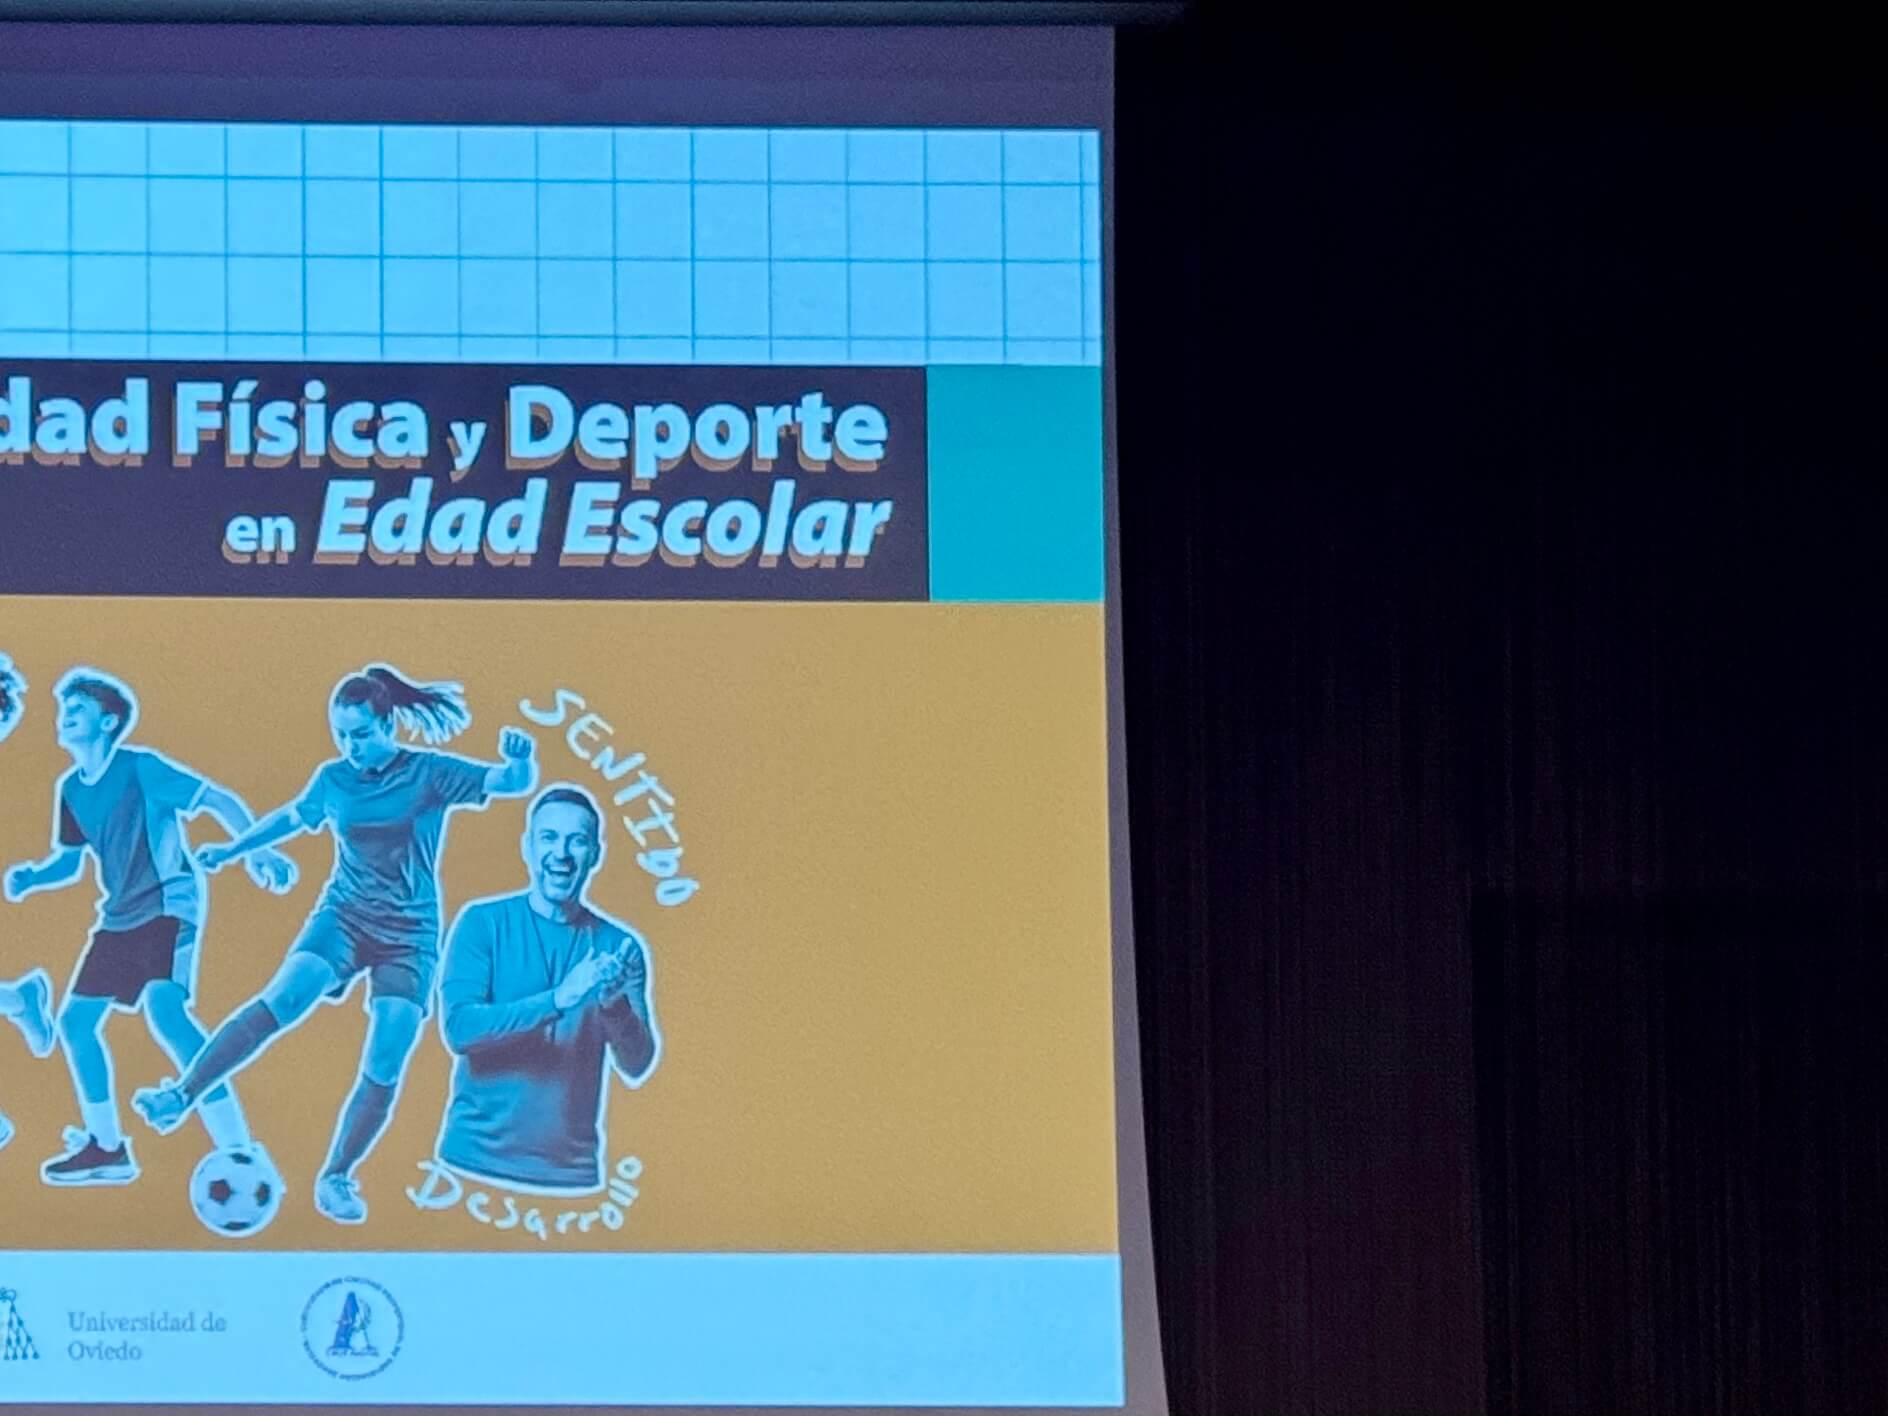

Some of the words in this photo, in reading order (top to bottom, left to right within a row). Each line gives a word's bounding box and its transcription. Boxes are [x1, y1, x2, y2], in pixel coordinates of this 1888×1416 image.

[174, 378, 430, 465] Física
[450, 422, 488, 474] y
[509, 384, 890, 478] Deporte
[226, 516, 296, 556] en
[316, 478, 534, 560] Edad
[562, 484, 894, 564] Escolar
[518, 688, 701, 907] SENTIDO
[405, 1155, 644, 1240] Desarrollo
[66, 1340, 143, 1362] Oviedo
[67, 1310, 195, 1333] Universidad
[199, 1310, 228, 1333] de
